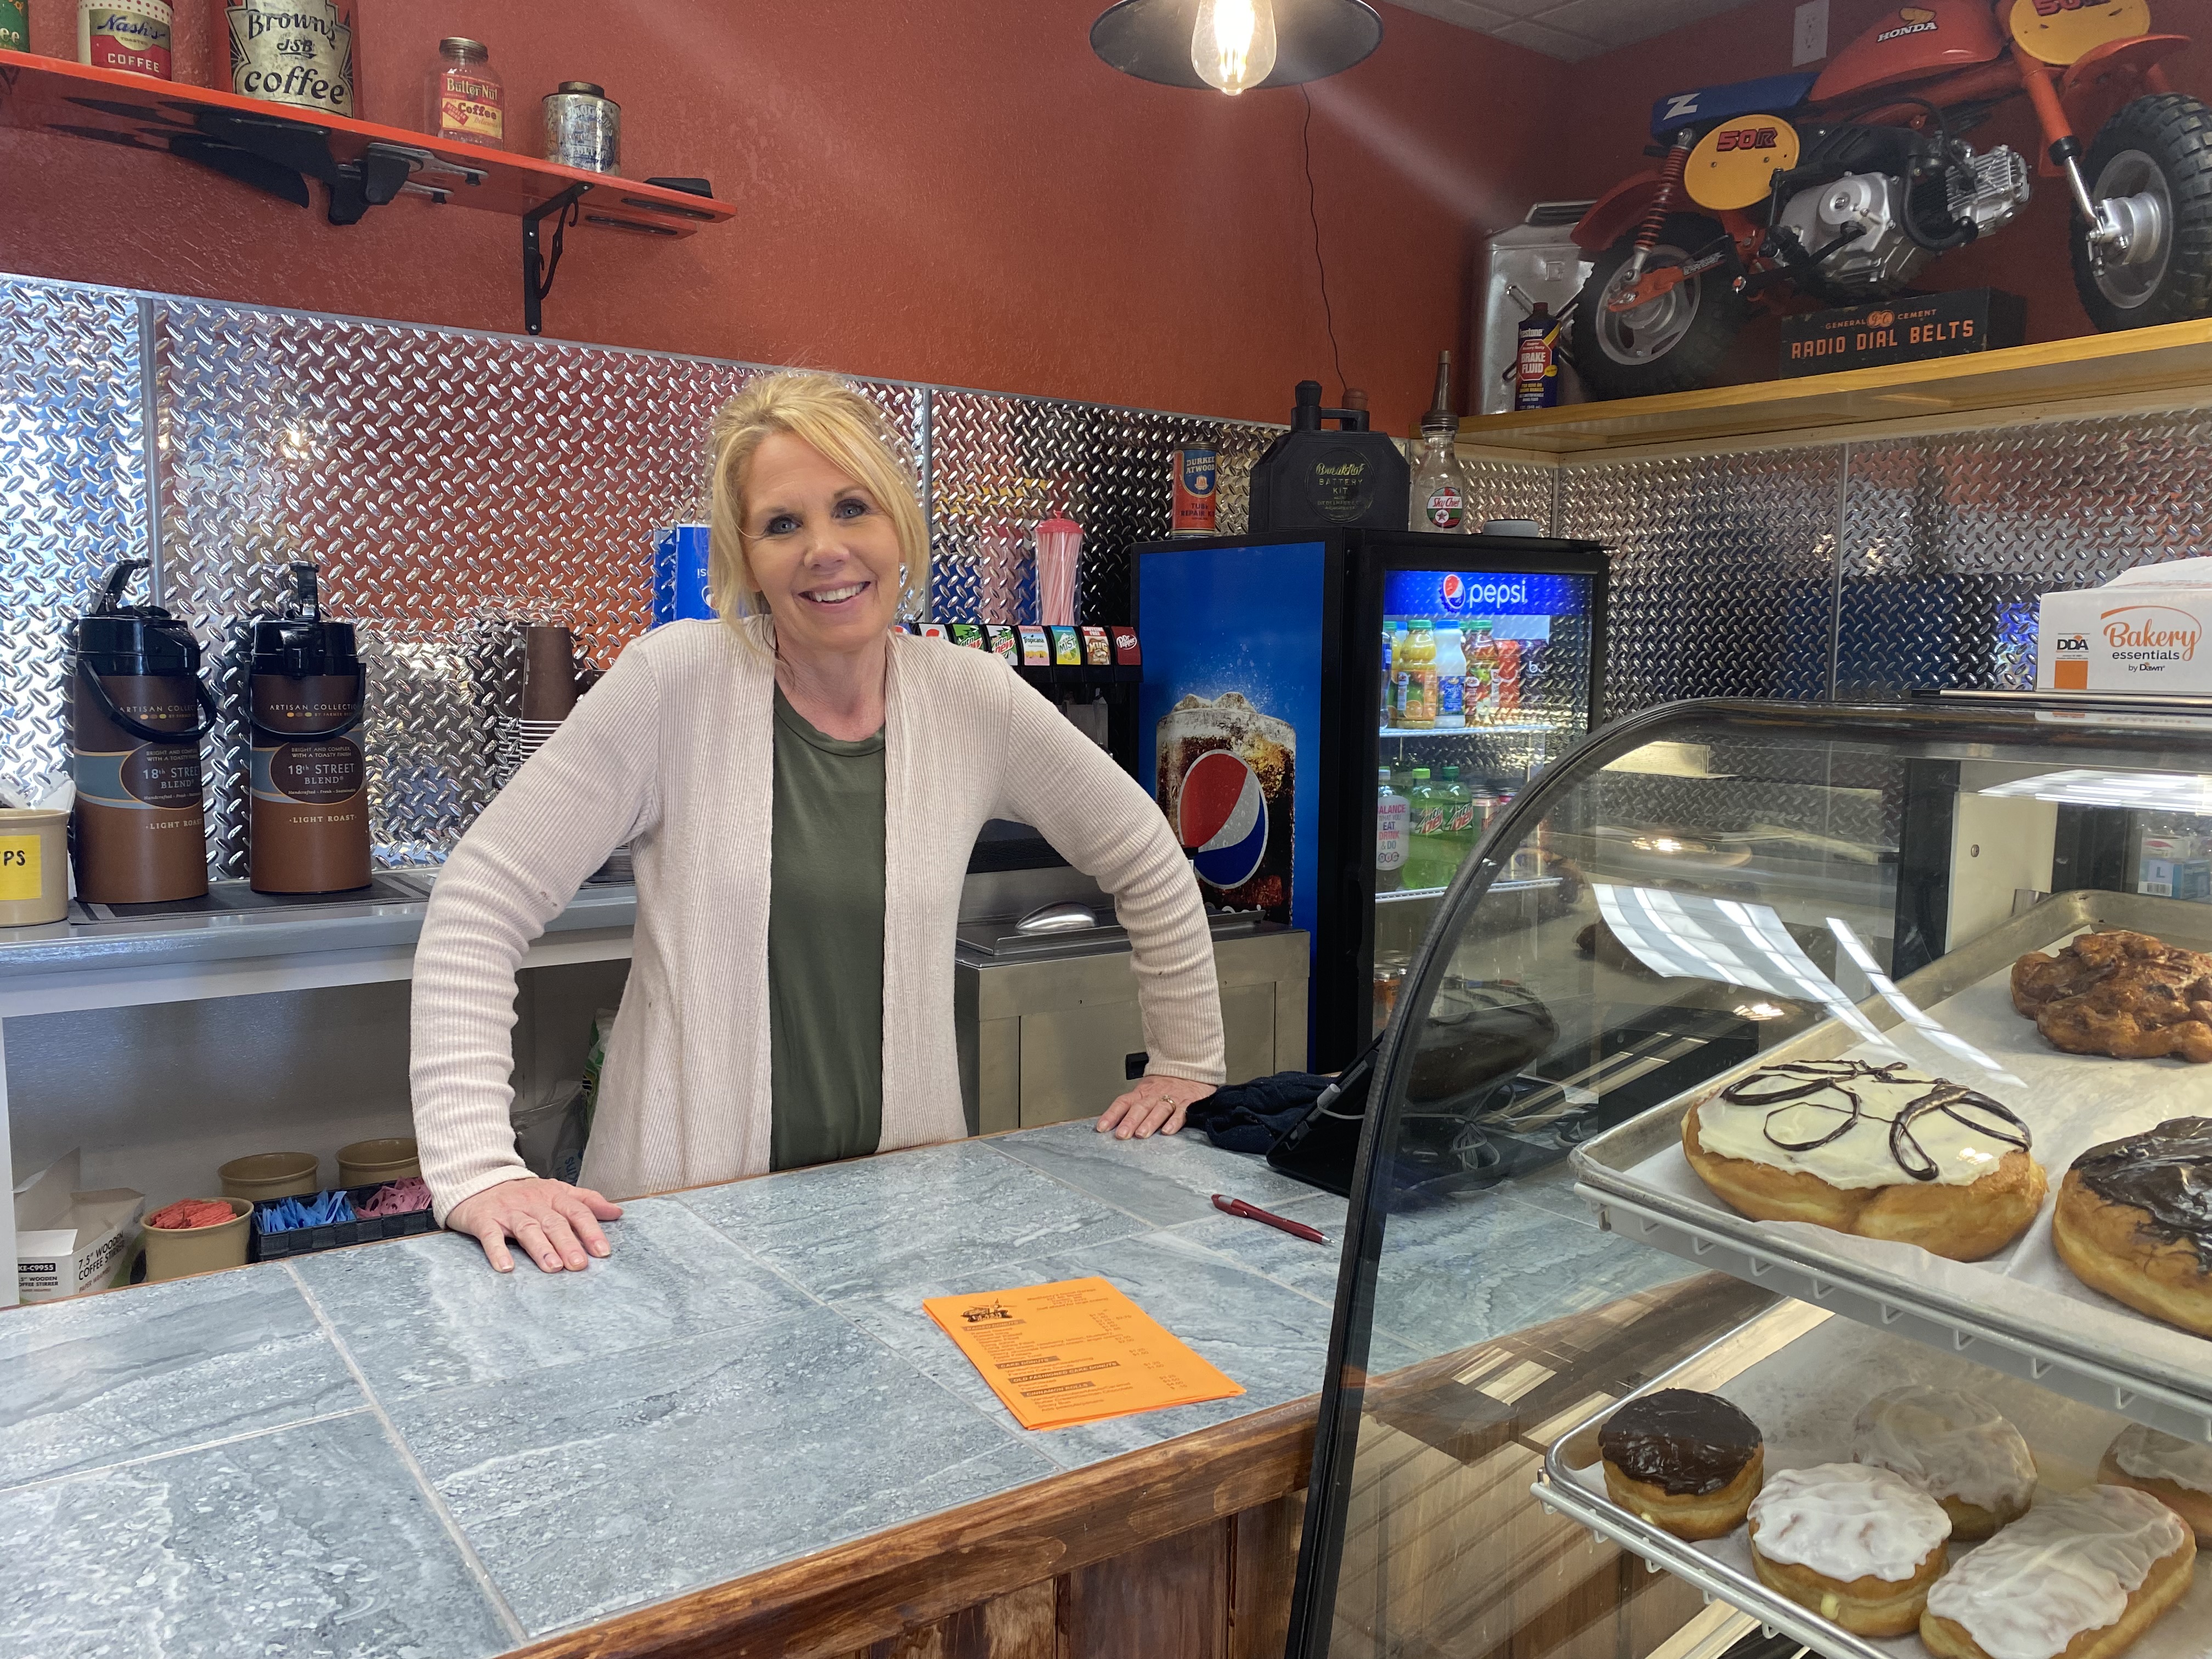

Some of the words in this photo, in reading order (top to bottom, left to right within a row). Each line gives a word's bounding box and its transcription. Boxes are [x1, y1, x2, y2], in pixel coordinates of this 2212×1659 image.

[97, 14, 166, 40] Nash's
[1877, 22, 1938, 42] HONDA
[108, 53, 160, 73] COFFEE
[244, 66, 345, 104] coffee
[458, 103, 496, 120] Coffee
[1663, 93, 1701, 121] Z
[1717, 127, 1778, 152] 50R
[1825, 319, 1867, 329] GENERAL
[1897, 309, 1937, 320] CEMENT
[1791, 336, 1846, 359] RADIO
[1857, 329, 1898, 351] DIAL
[1910, 319, 1974, 344] BELTS
[1521, 352, 1545, 363] BRAKE
[1522, 363, 1544, 374] FLUID
[1186, 464, 1215, 474] ATWOOD
[1433, 498, 1446, 509] Sky
[1446, 498, 1460, 507] Chief
[1469, 580, 1526, 608] pepsi
[1059, 635, 1074, 645] SIERRA
[1059, 637, 1076, 653] MIST
[1118, 636, 1136, 648] Pepper
[2057, 639, 2089, 650] DDA
[2103, 618, 2196, 662] Bakery
[1089, 642, 1108, 653] MUG
[2112, 650, 2180, 660] essentials
[2128, 664, 2138, 673] by
[2140, 663, 2163, 672] Dawn
[143, 769, 166, 780] 18th
[171, 766, 200, 778] STREE
[288, 765, 309, 775] 18th
[315, 763, 354, 775] STREET
[1378, 804, 1406, 814] ALANCE
[150, 821, 180, 830] LIGHT
[1383, 821, 1396, 831] EAT
[1378, 831, 1400, 840] DRINK
[1381, 841, 1386, 850] &
[1387, 840, 1397, 849] DO
[0, 850, 25, 866] PS
[2156, 866, 2165, 878] L
[95, 1231, 123, 1257] WOODEN
[78, 1259, 103, 1280] COFFEE
